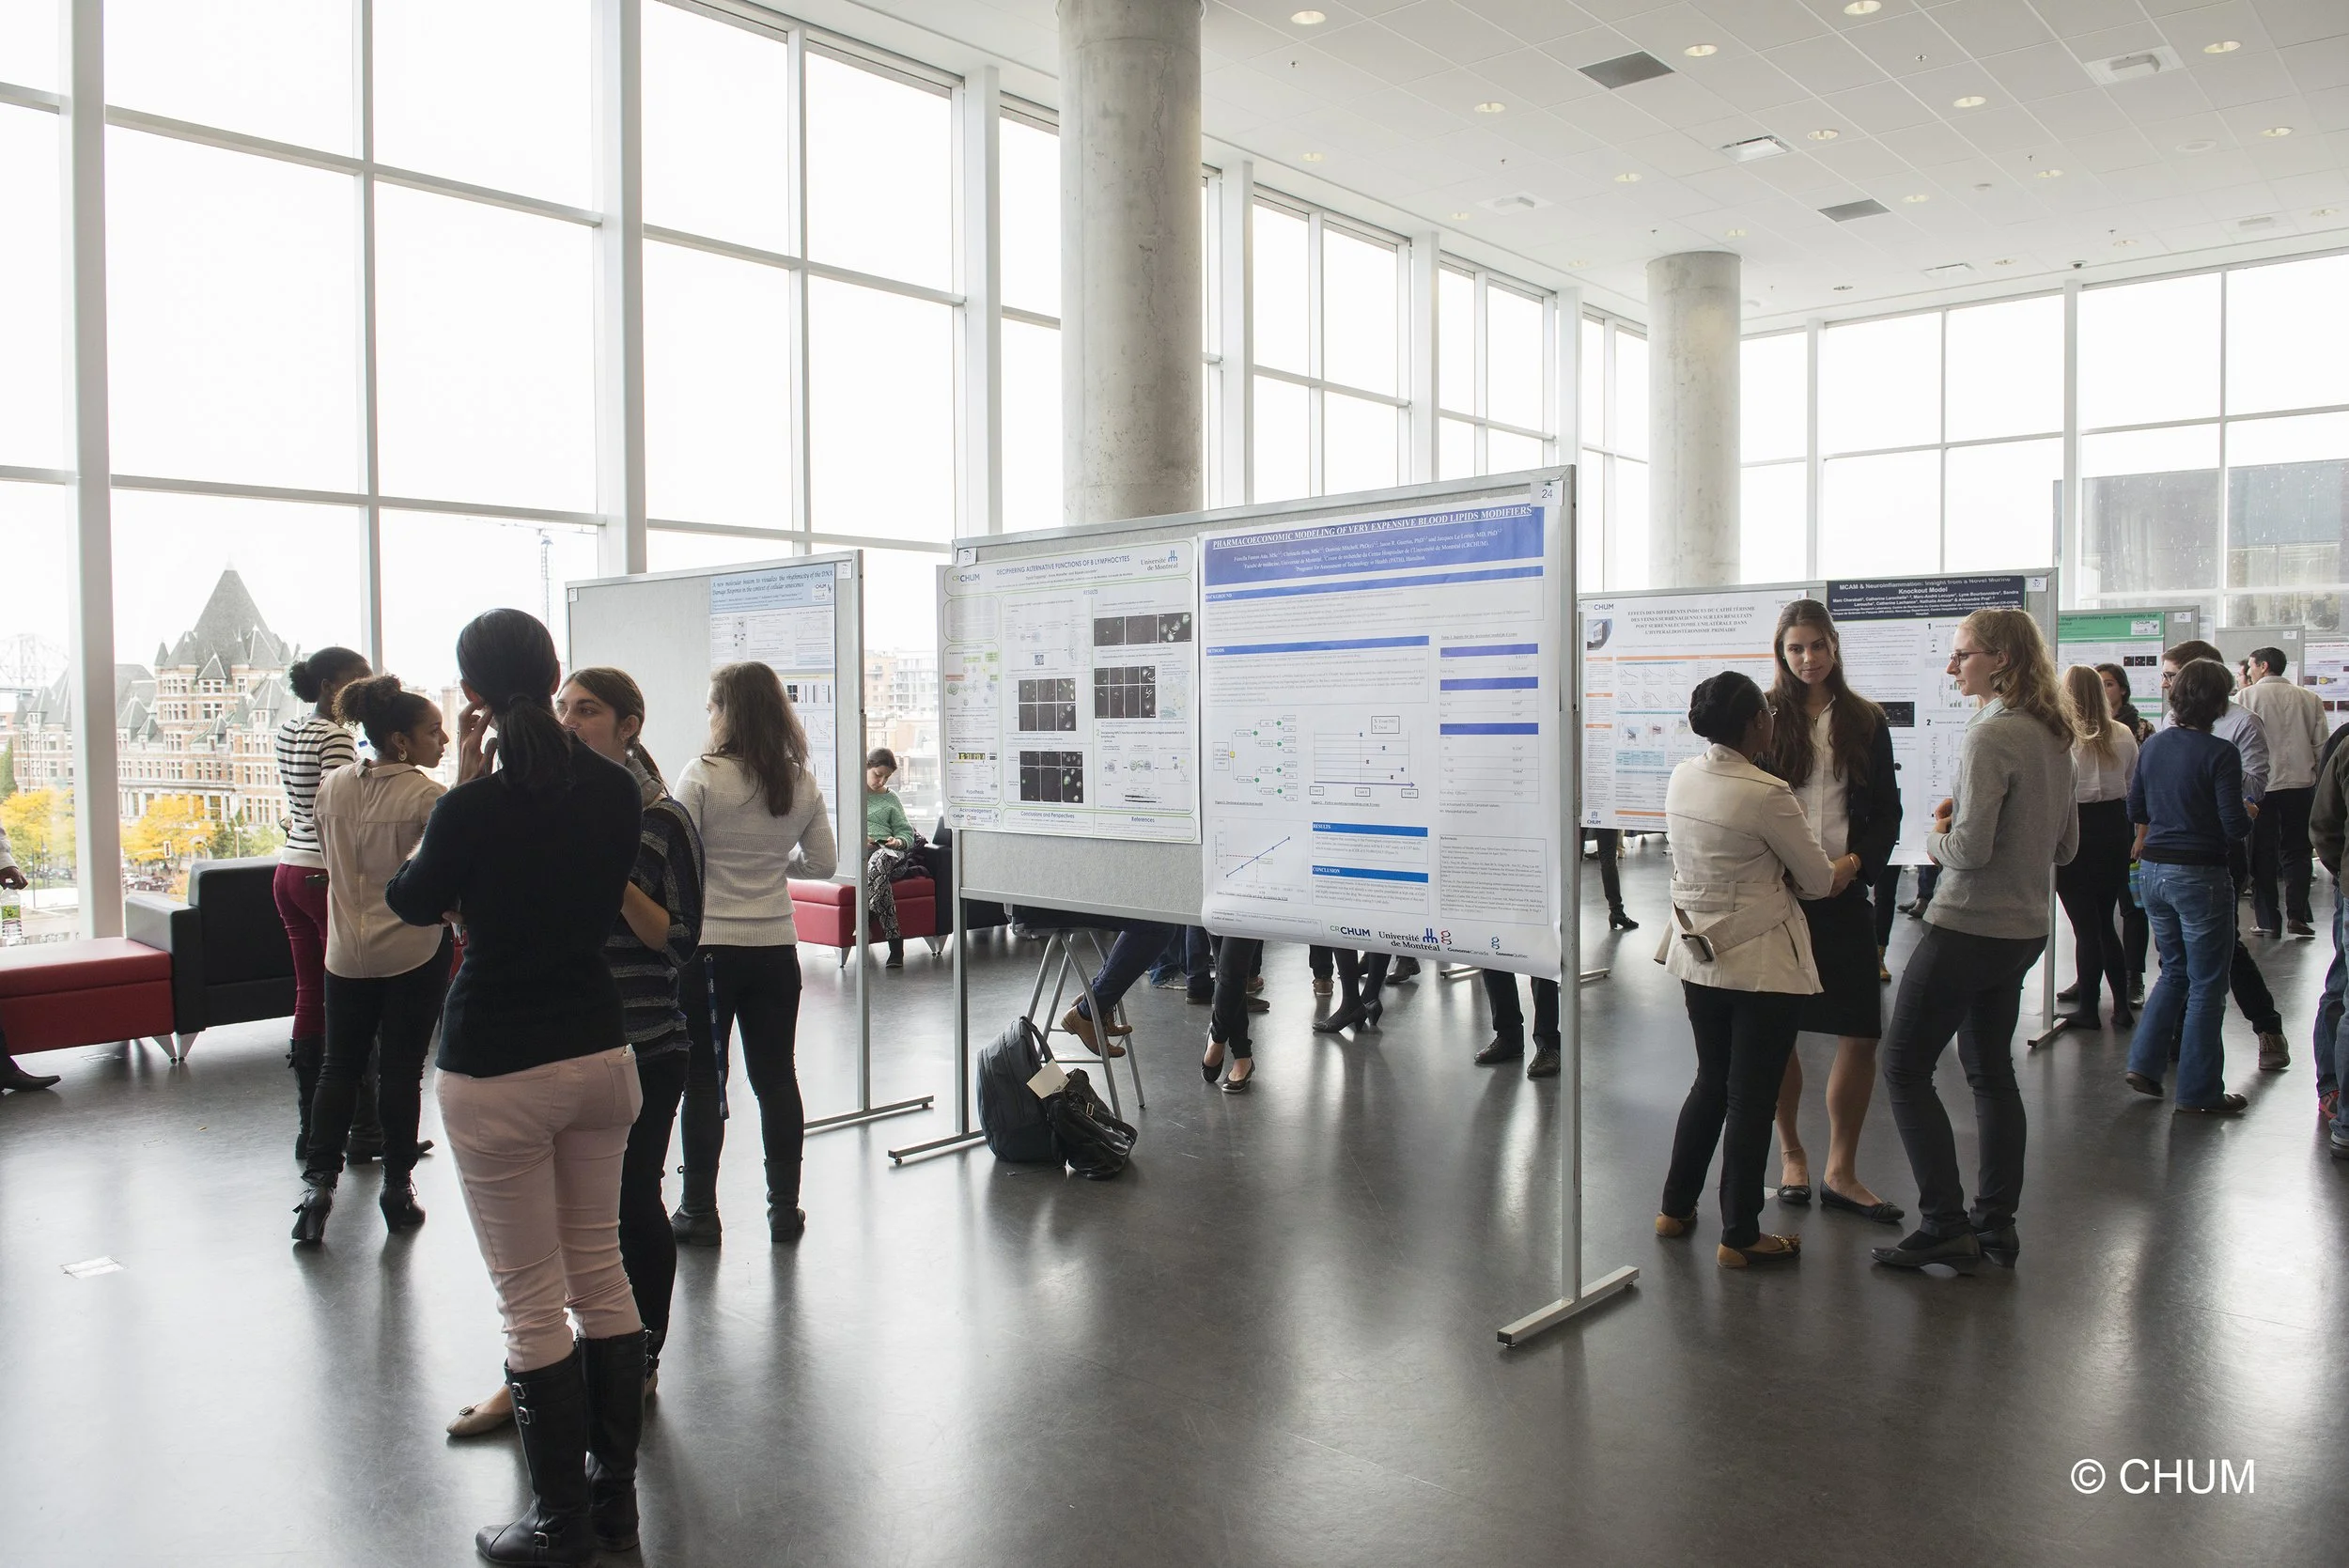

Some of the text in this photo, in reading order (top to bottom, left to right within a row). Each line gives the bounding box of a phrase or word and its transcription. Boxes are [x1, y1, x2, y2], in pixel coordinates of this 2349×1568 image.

[1542, 489, 1553, 498] 24
[1213, 506, 1532, 548] PHARMACOECONOMIC MODELING OF VERY EXPENSIVE BLOOD LIPIDS MODIFIERS
[997, 565, 1024, 576] DECIPHERING
[1026, 564, 1054, 573] ALTERNATIVE
[1055, 560, 1081, 570] FUNCTIONS
[1082, 559, 1089, 567] OF
[1095, 555, 1130, 566] LYMPHOCYTES
[1141, 556, 1166, 566] Université
[1154, 562, 1178, 571] Montréal
[1050, 812, 1075, 820] Perspectives
[1378, 931, 1420, 942] Université
[1403, 941, 1440, 952] Montréal
